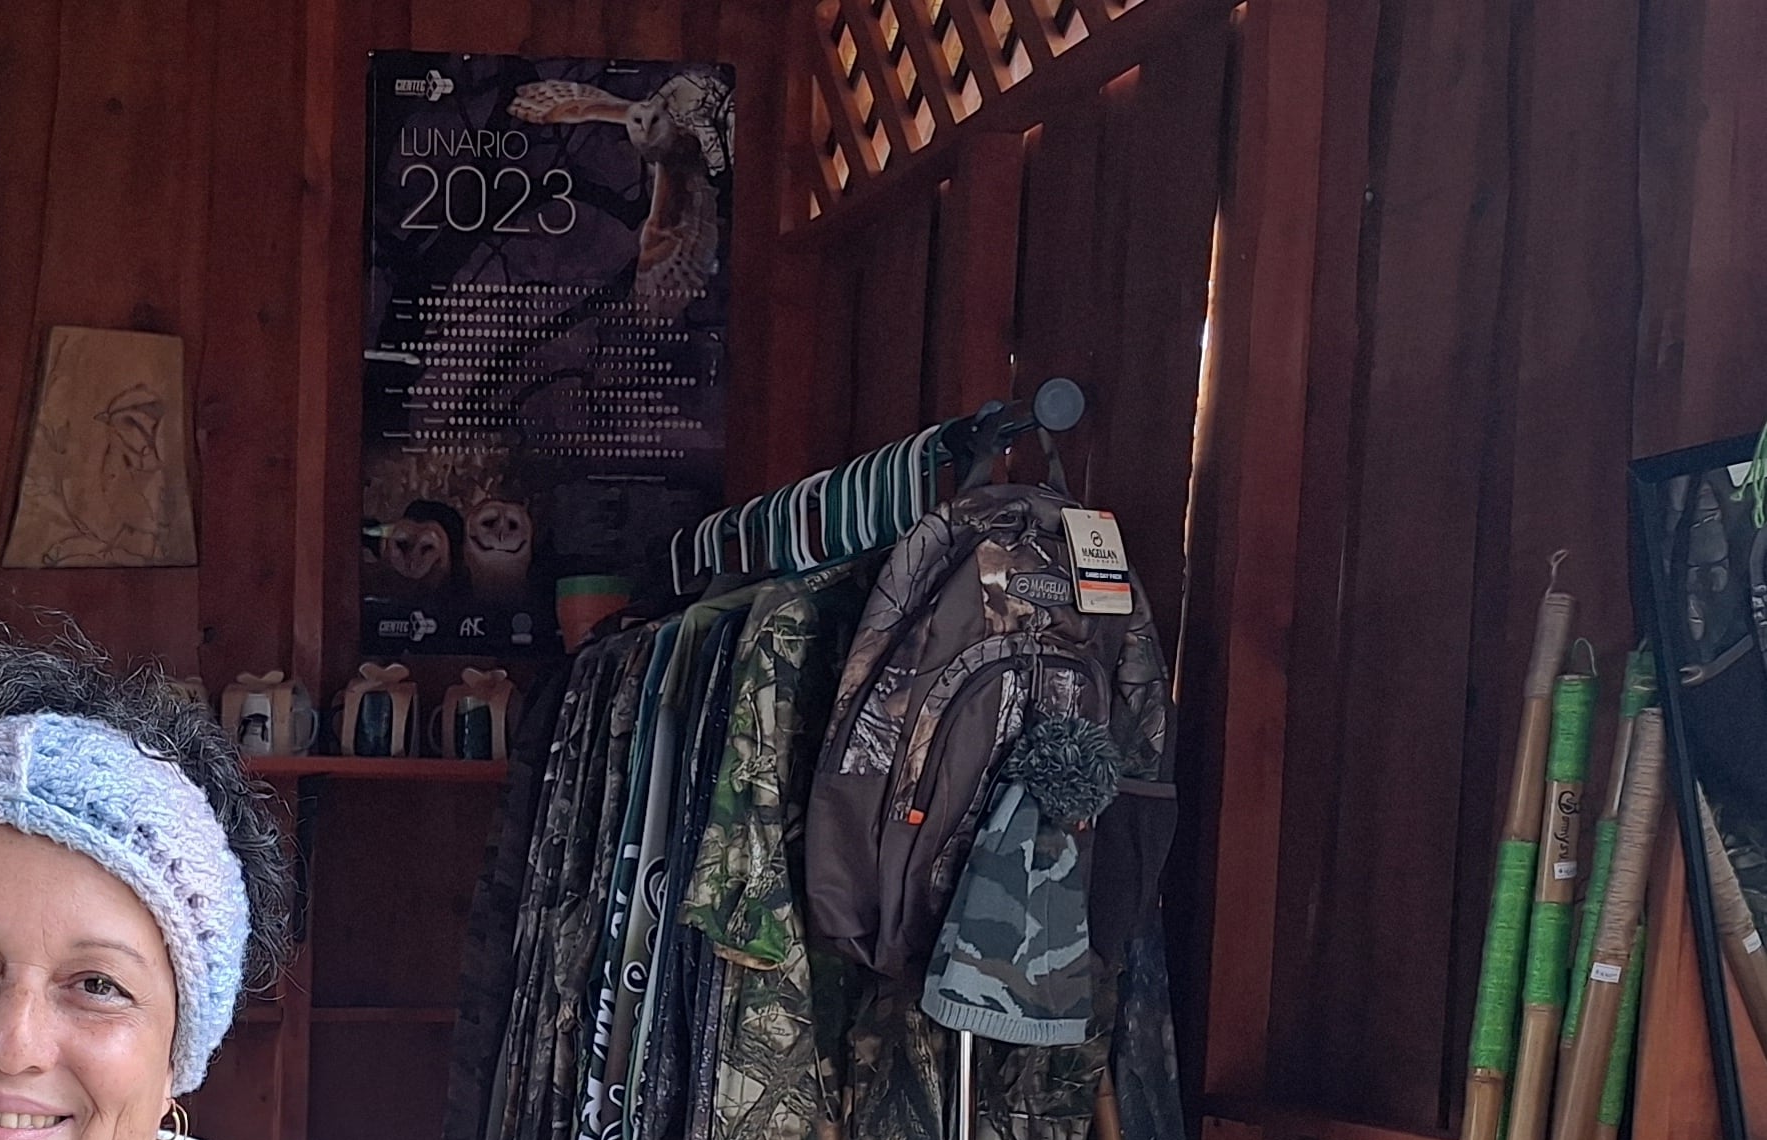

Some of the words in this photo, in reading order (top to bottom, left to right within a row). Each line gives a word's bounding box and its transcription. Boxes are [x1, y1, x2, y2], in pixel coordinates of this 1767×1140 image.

[400, 127, 529, 159] LUNARIO
[400, 166, 578, 236] 2023
[1081, 547, 1118, 561] MAGELLAN
[1029, 578, 1070, 596] MAGELLA
